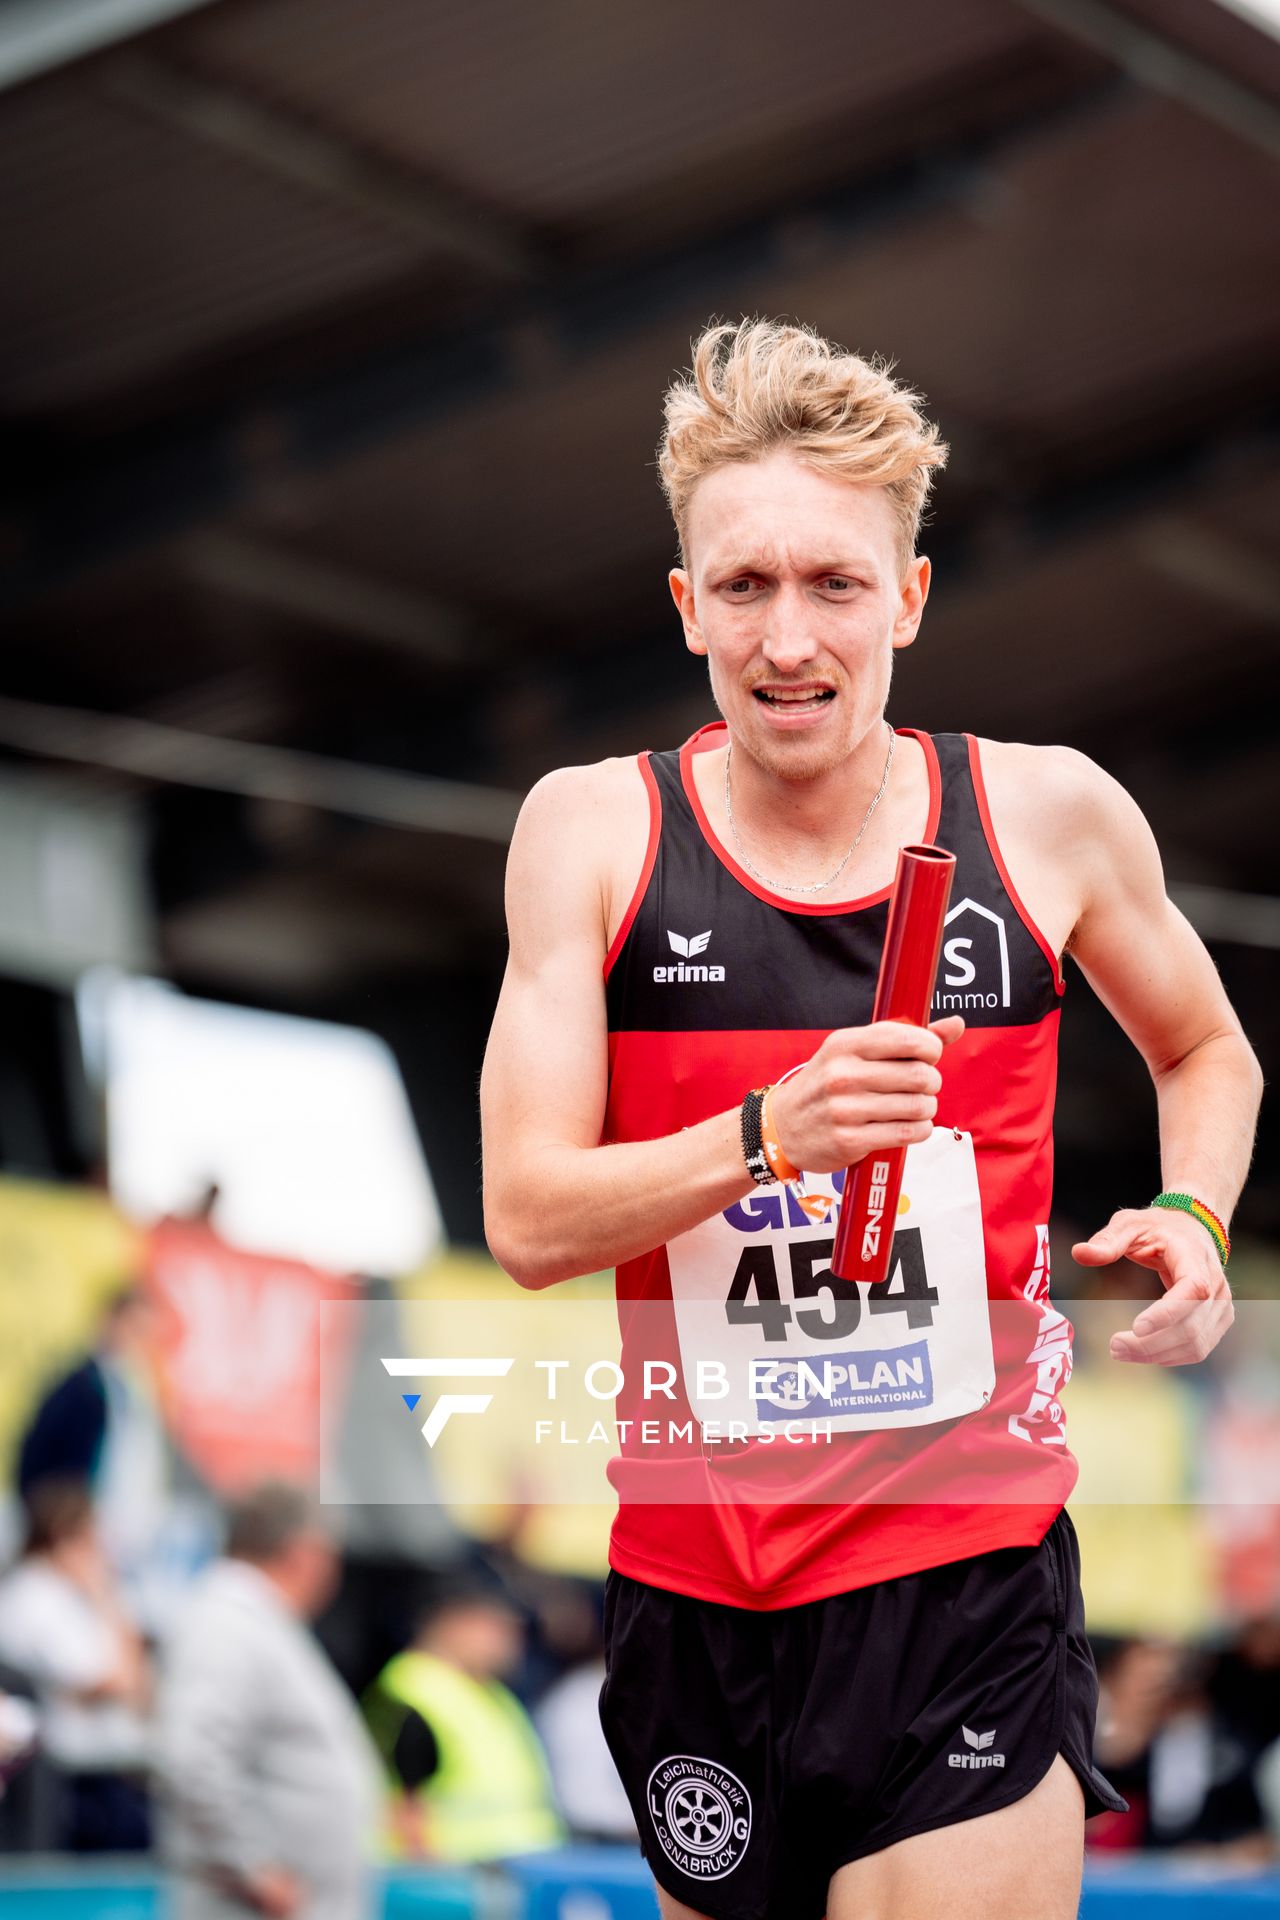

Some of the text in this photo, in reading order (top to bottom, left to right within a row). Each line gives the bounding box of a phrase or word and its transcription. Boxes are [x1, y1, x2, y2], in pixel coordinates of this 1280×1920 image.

[653, 962, 726, 983] erima
[725, 1226, 940, 1342] 454
[829, 1357, 924, 1393] PLAN
[829, 1390, 927, 1408] INTERNATIONAL
[948, 1752, 1006, 1769] erima
[655, 1761, 744, 1808] Leichtathletik
[659, 1826, 737, 1874] OSNABRÜCK
